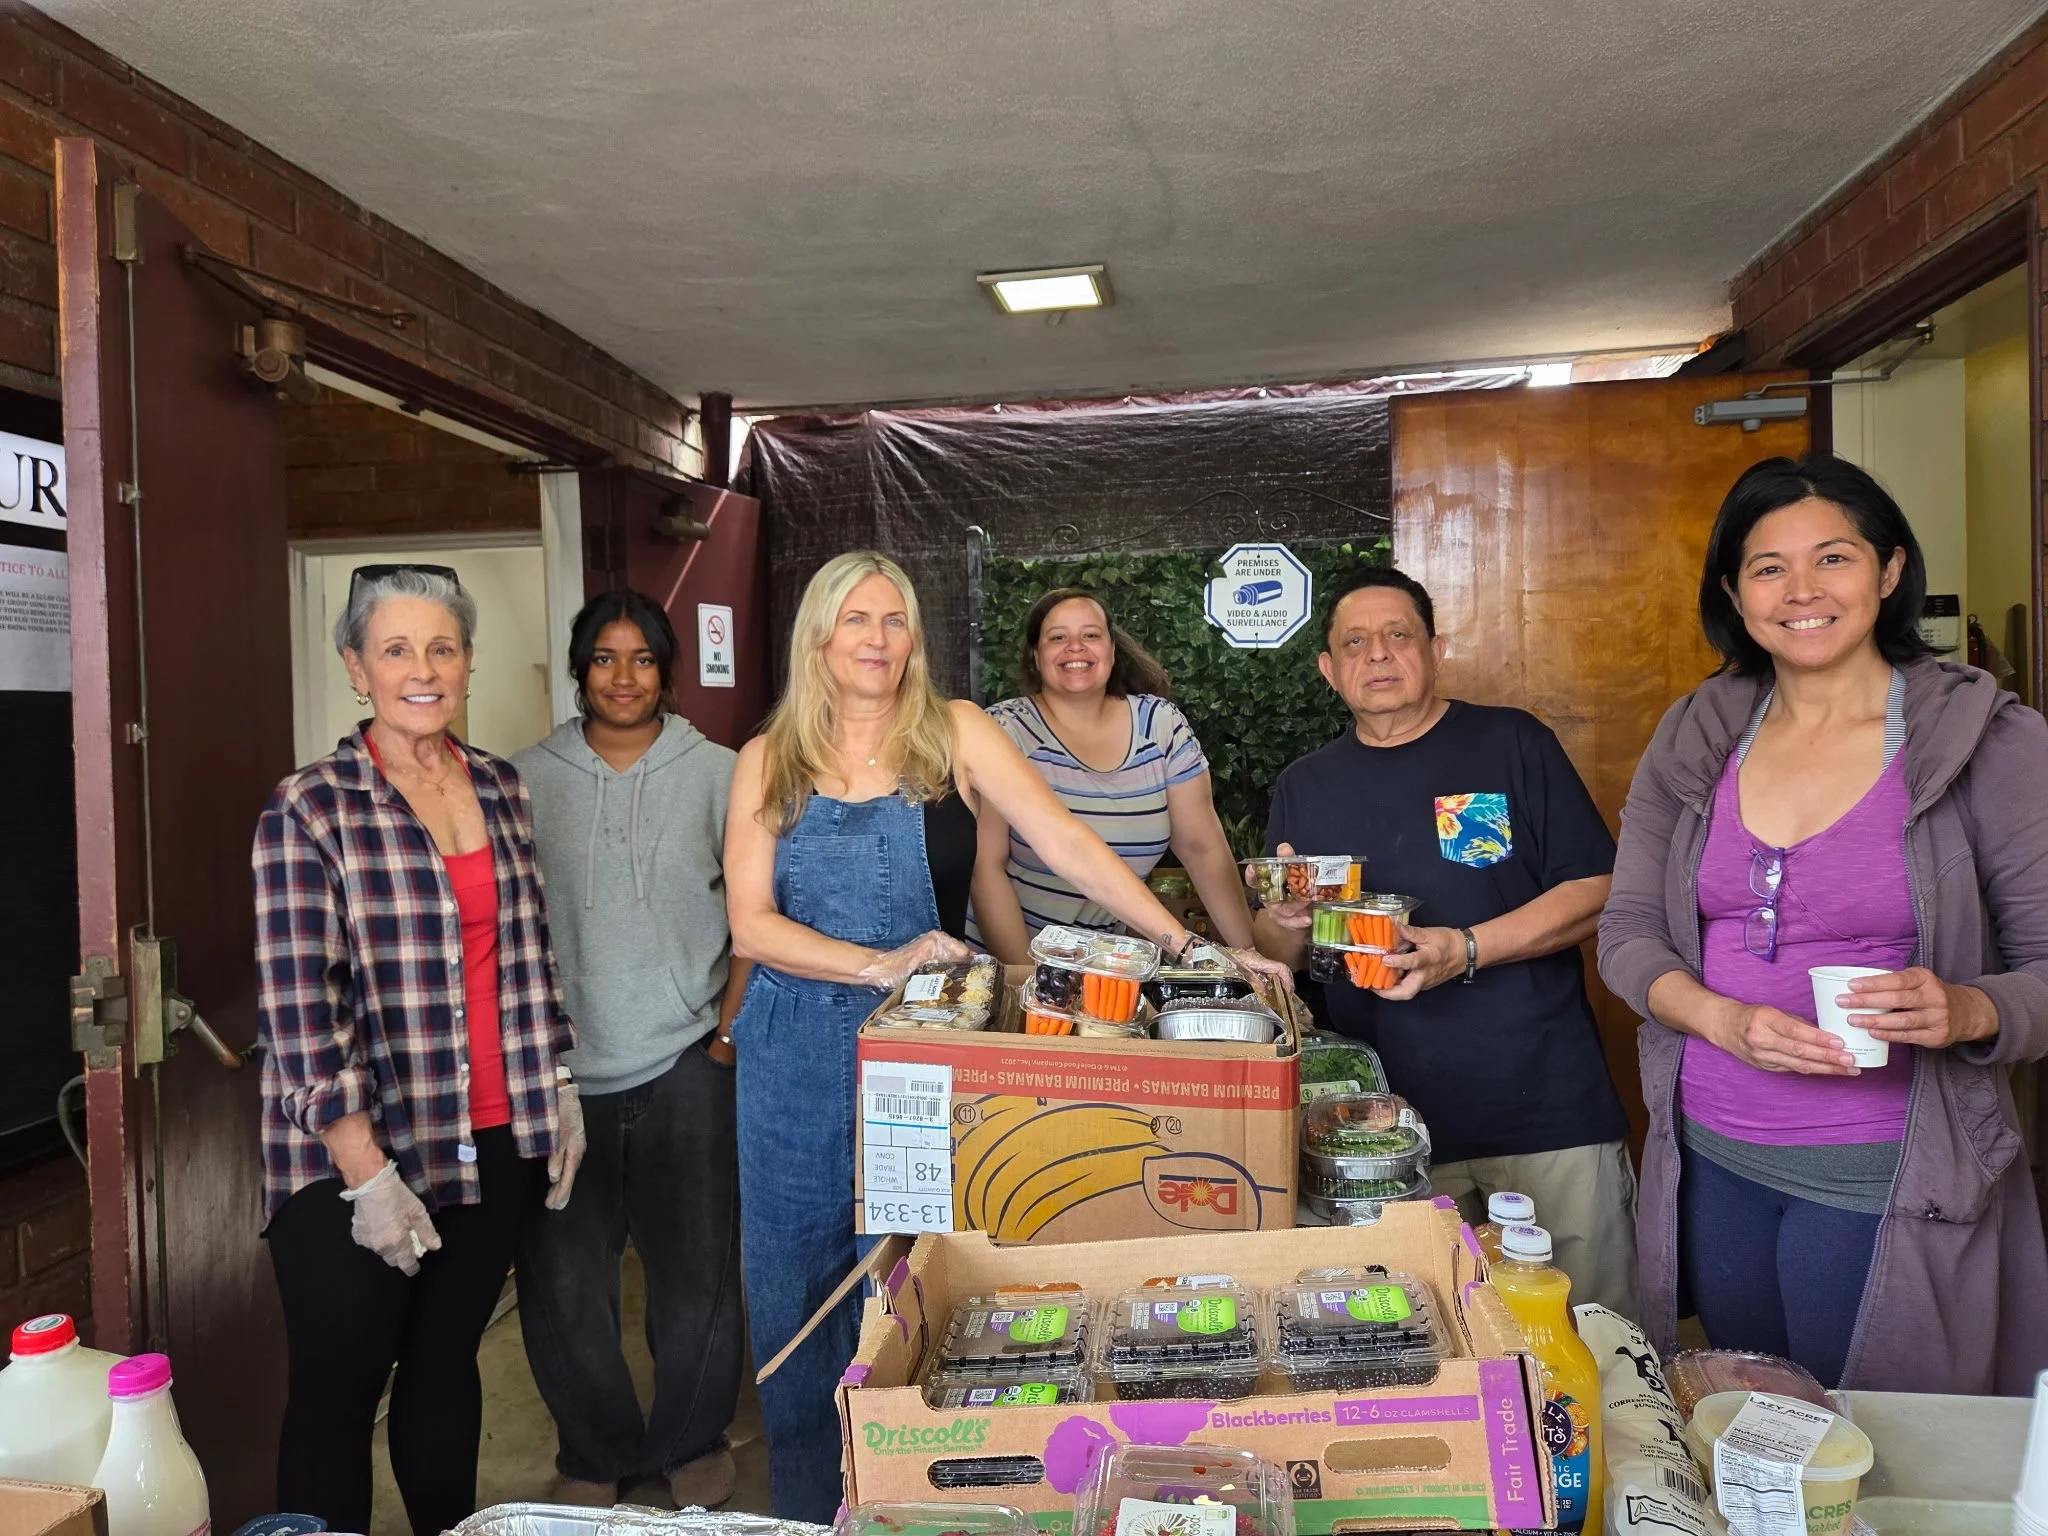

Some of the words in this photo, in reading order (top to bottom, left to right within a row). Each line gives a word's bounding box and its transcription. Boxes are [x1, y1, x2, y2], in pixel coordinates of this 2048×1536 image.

[1237, 559, 1280, 567] PREMISES
[28, 564, 44, 577] TO
[1235, 568, 1252, 576] ARE
[1253, 568, 1281, 577] UNDER
[1227, 610, 1251, 618] VIDEO
[1254, 610, 1260, 618] &
[1261, 610, 1288, 618] AUDIO
[1227, 619, 1288, 627] SURVEILLANCE
[713, 651, 722, 662] NO
[705, 664, 730, 675] SMOKING
[1001, 1057, 1016, 1065] 2021
[1063, 1060, 1080, 1069] Food
[1079, 1062, 1096, 1070] Dole
[997, 1071, 1062, 1087] BANANAS
[1066, 1075, 1130, 1093] PREMIUM
[1142, 1079, 1209, 1097] BANANAS
[1213, 1083, 1280, 1099] PREMIUM
[875, 1152, 894, 1160] CONV
[874, 1164, 896, 1172] TRADE
[915, 1162, 942, 1182] 48
[873, 1175, 899, 1183] WHOLE
[1158, 1180, 1238, 1215] Dole
[868, 1201, 947, 1225] 13-334
[1211, 1408, 1331, 1429] Blackberries
[1342, 1404, 1380, 1421] 12-6
[1401, 1407, 1469, 1418] CLAMSHELLS
[1749, 1397, 1785, 1411] LAZY
[1785, 1408, 1829, 1424] ACRES
[1496, 1398, 1519, 1456] Trade
[1734, 1427, 1775, 1443] Nutrition
[874, 1446, 894, 1457] Only
[895, 1447, 912, 1455] the
[913, 1446, 942, 1454] Finest
[1504, 1464, 1525, 1502] Fair
